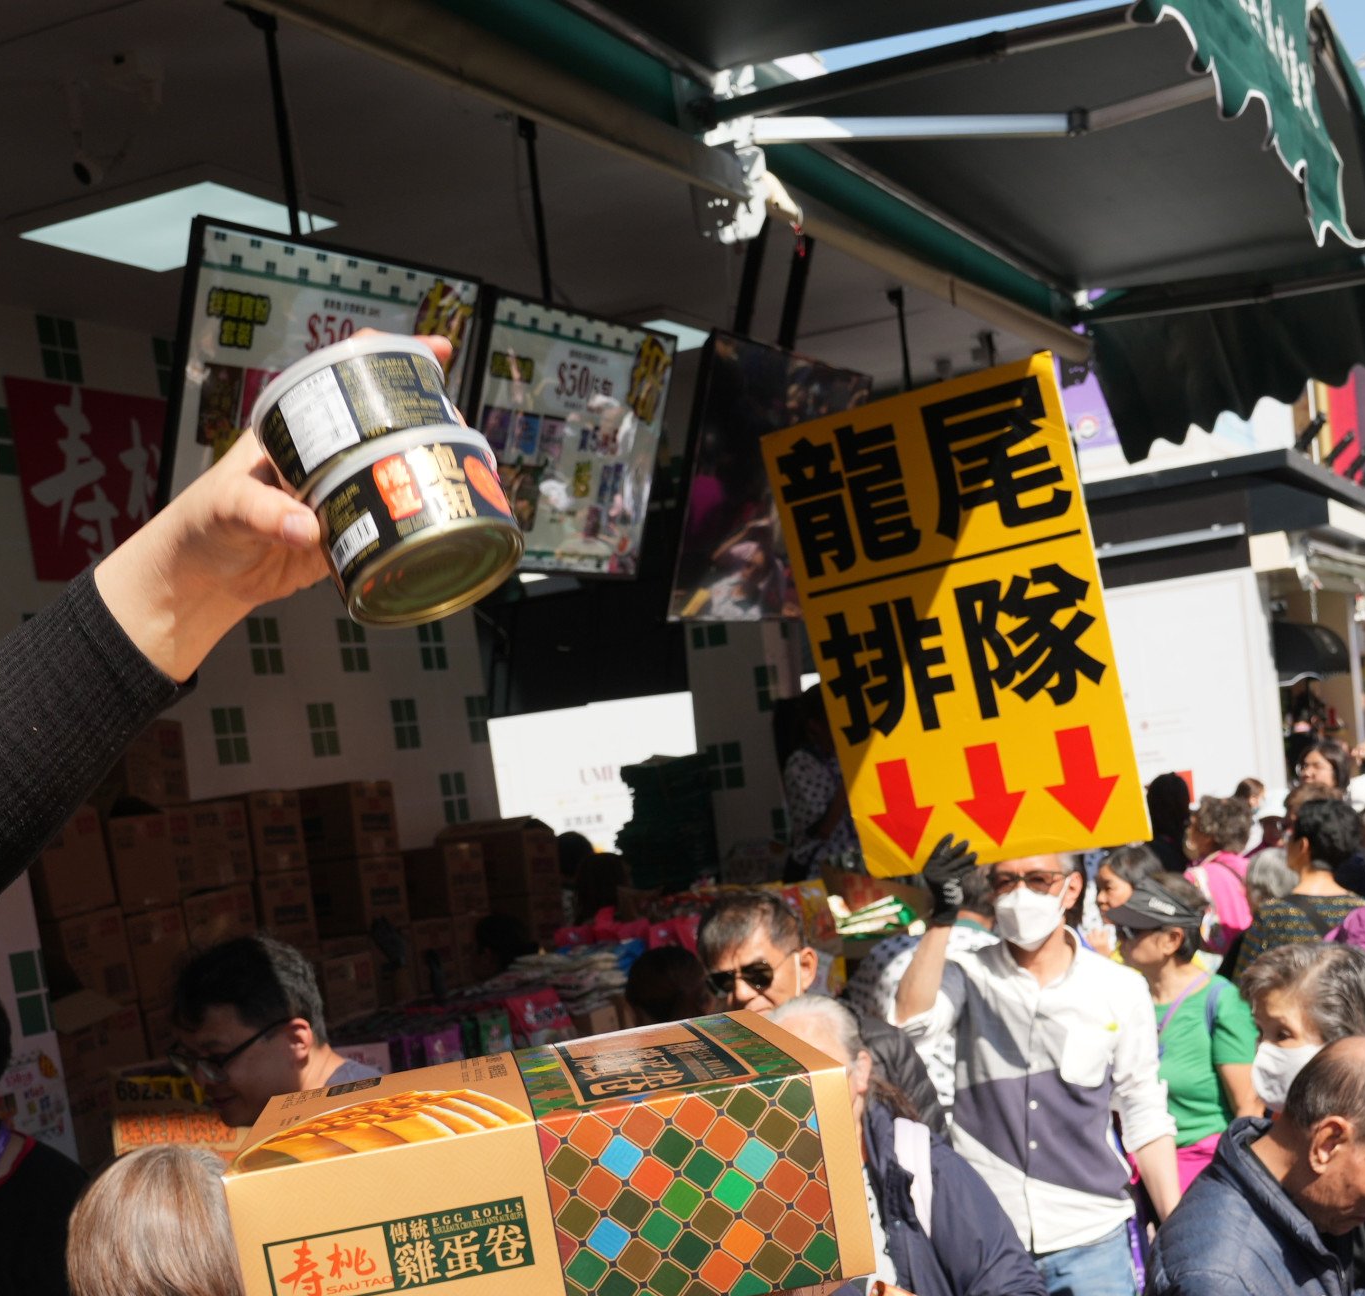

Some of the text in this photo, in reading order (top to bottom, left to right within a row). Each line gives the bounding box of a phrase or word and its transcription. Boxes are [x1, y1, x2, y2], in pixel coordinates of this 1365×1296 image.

[776, 375, 1072, 578] 龍尾
[820, 563, 1106, 746] 排隊
[389, 1218, 430, 1245] 傳統
[432, 1201, 523, 1228] EGG ROLLS
[394, 1224, 527, 1288] 雞蛋卷
